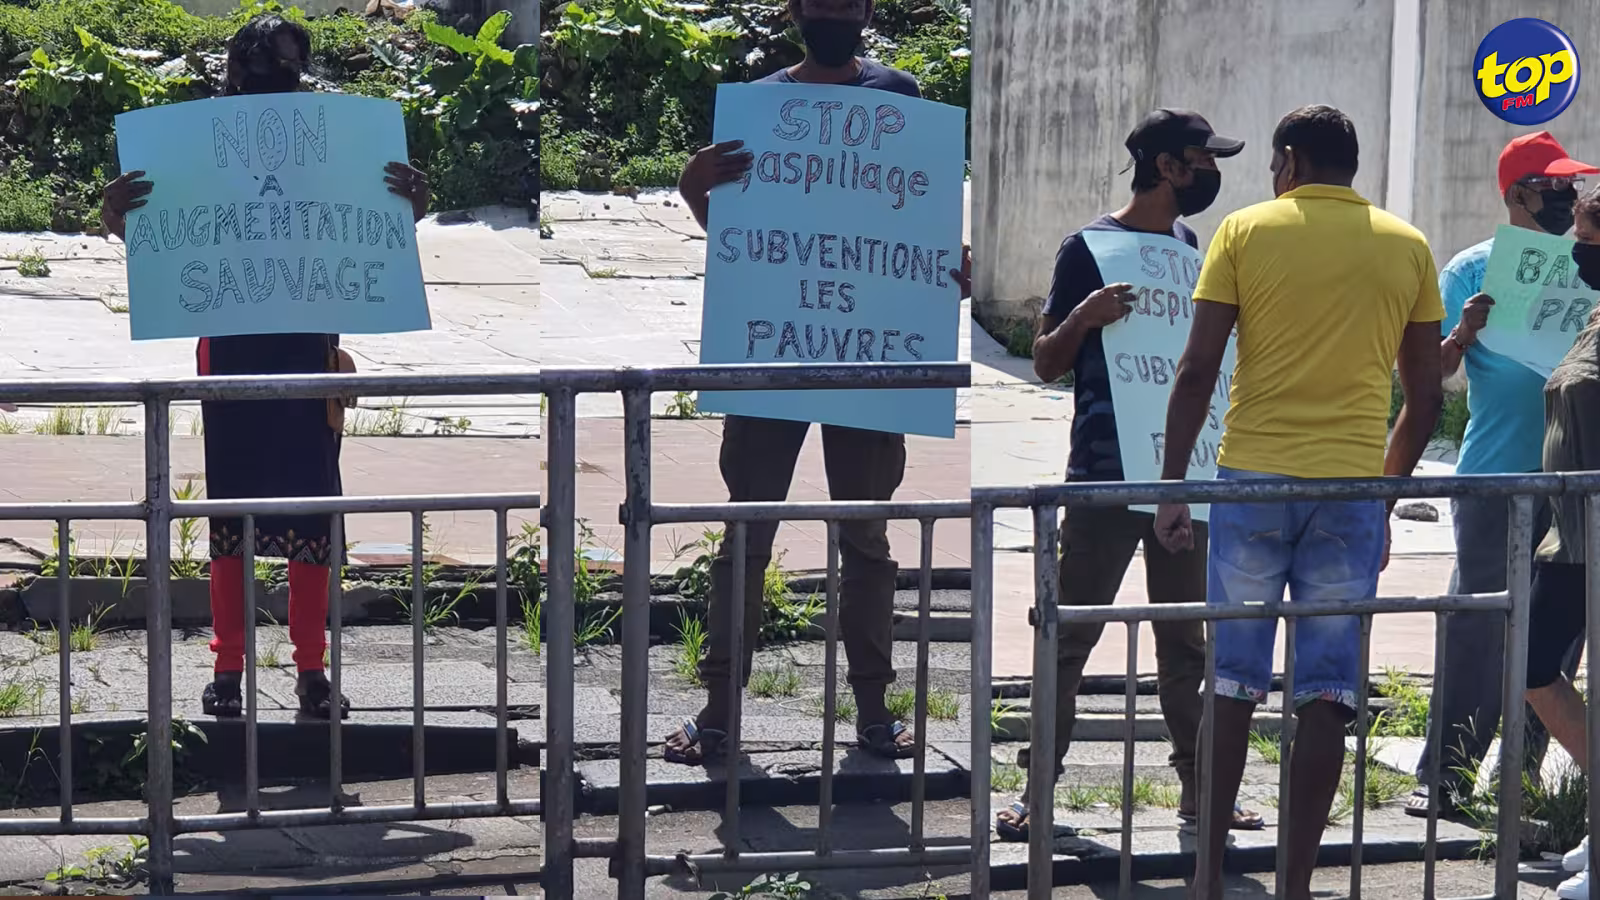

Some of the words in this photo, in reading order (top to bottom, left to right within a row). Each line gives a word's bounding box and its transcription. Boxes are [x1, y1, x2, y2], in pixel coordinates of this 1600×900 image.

[211, 105, 327, 171] NON
[772, 98, 906, 150] STOP
[129, 200, 406, 256] AUGMENTATION
[178, 256, 386, 312] SAUVAGE
[716, 227, 950, 289] SUBVENTIONE
[1140, 245, 1202, 290] STO
[799, 279, 857, 314] LES
[746, 320, 925, 362] PAUVRES
